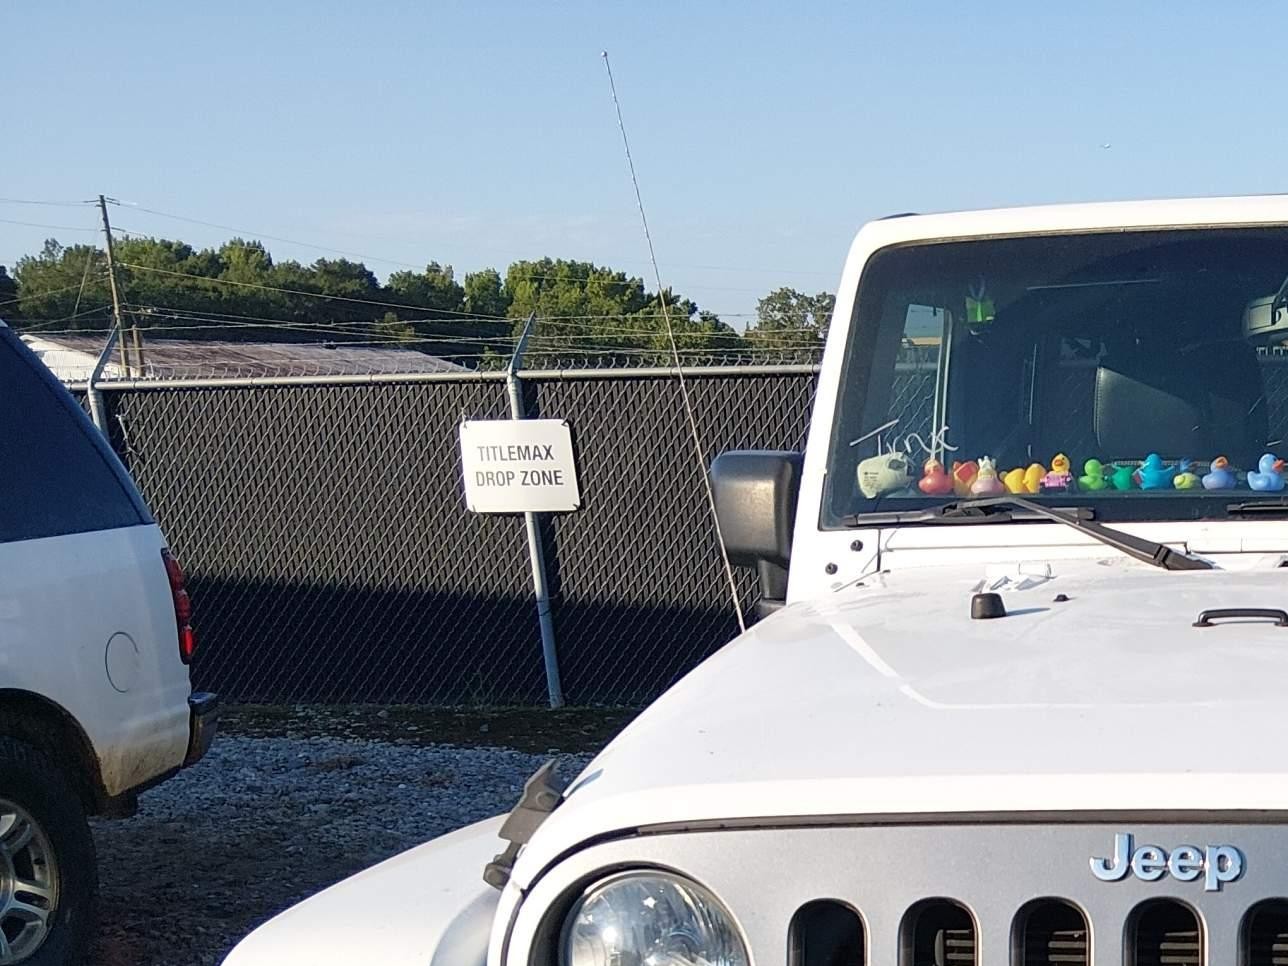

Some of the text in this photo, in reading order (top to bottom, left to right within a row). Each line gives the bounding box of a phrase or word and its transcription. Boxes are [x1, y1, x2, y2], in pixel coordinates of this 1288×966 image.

[477, 444, 554, 462] TITLEMAX
[475, 470, 564, 487] DROP ZONE
[1089, 832, 1244, 891] Jeep
